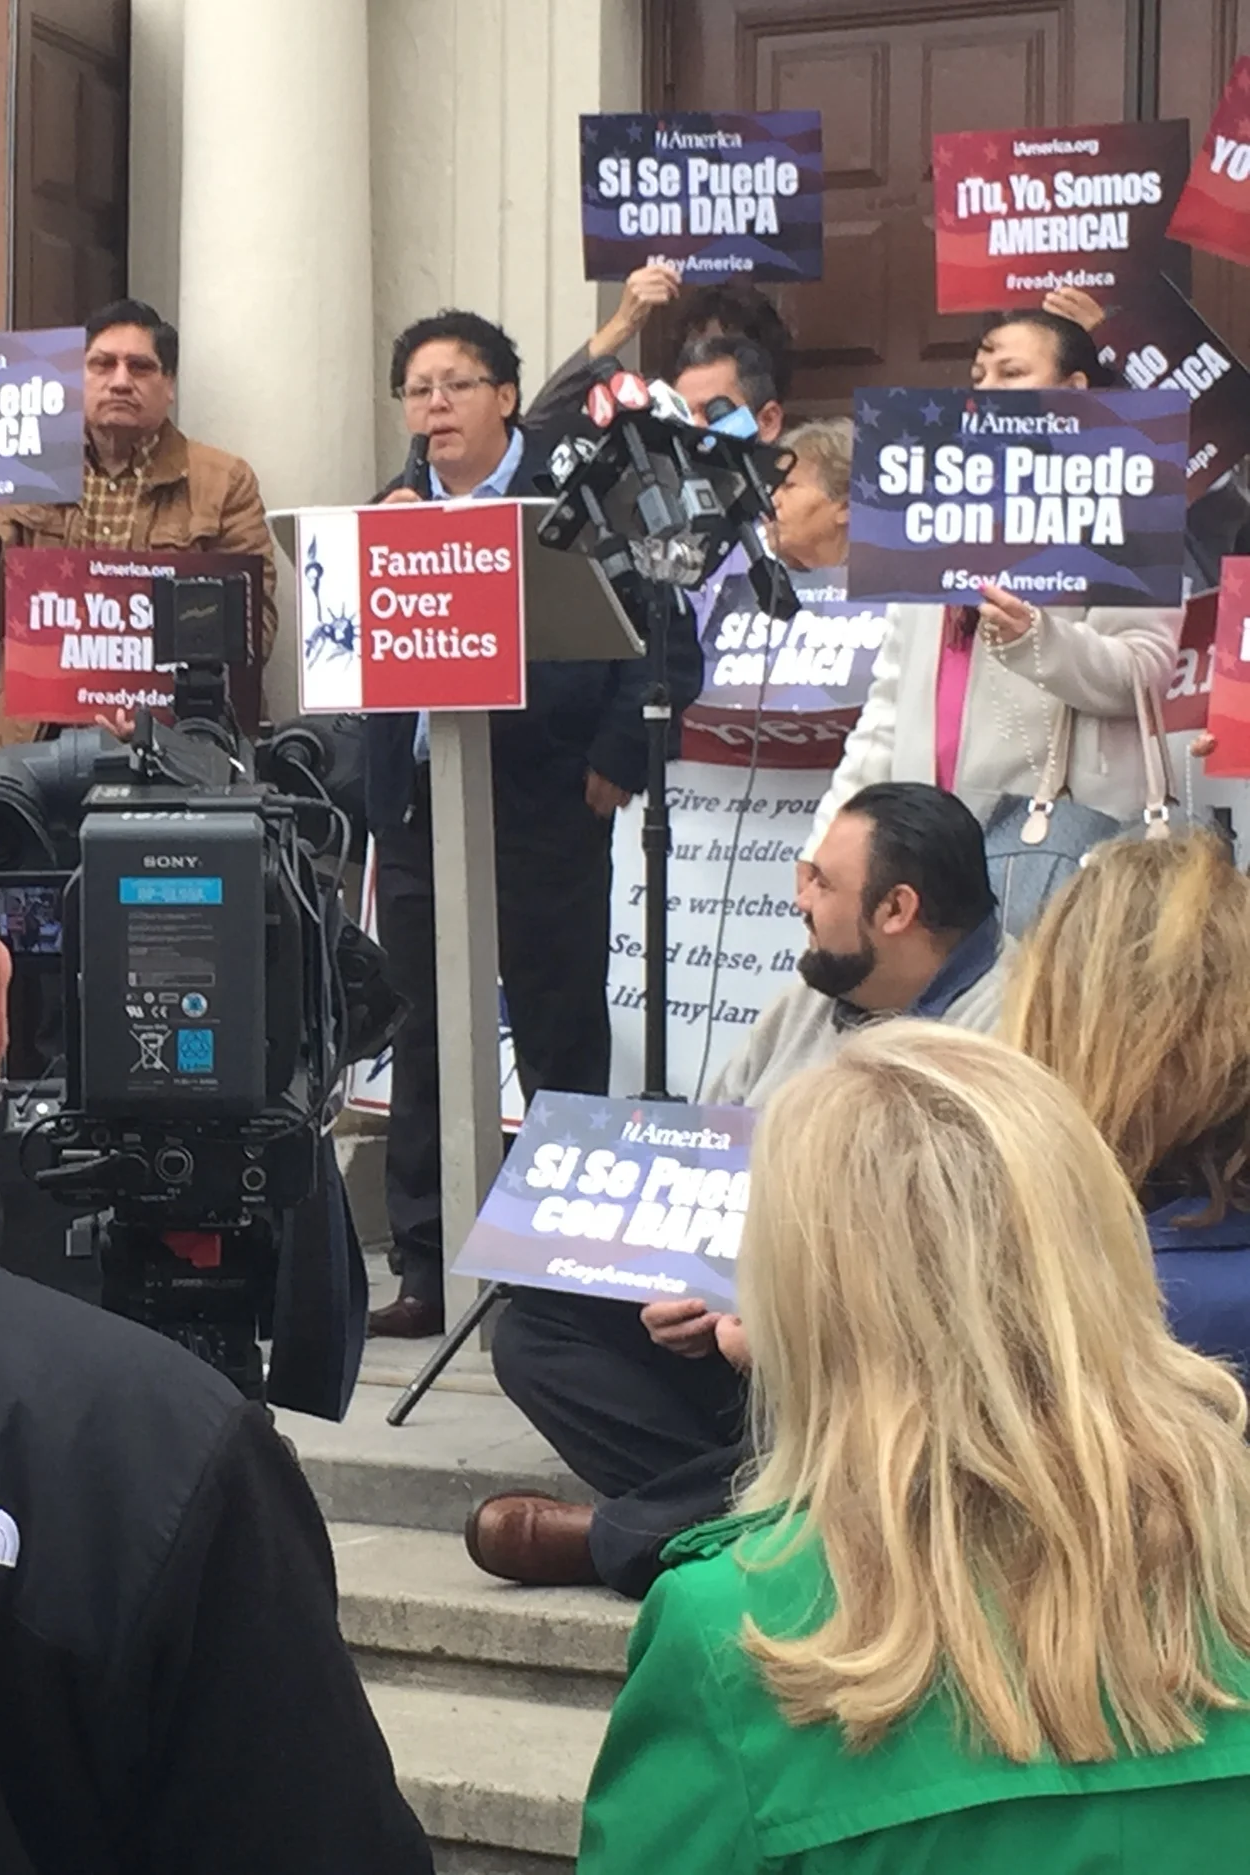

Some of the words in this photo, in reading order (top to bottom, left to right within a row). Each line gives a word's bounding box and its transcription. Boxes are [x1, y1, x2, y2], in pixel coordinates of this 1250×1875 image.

[598, 157, 631, 197] Si
[637, 157, 680, 197] Se
[688, 156, 798, 196] Puede
[1009, 175, 1051, 212] Yo,
[1054, 171, 1162, 209] Somos
[619, 202, 682, 235] con
[690, 196, 779, 234] DAPA
[988, 212, 1129, 256] AMERICA!
[1006, 270, 1115, 291] #ready4daca
[878, 445, 925, 495] Si
[934, 445, 993, 496] Se
[1004, 447, 1154, 497] Puede
[905, 501, 993, 544] con
[1004, 497, 1124, 545] DAPA
[369, 542, 511, 577] Families
[942, 570, 1087, 592] #SoyAmerica
[84, 593, 126, 632] Yo,
[370, 587, 453, 618] Over
[371, 627, 498, 660] Politics
[664, 786, 720, 812] Give
[724, 799, 767, 814] me
[143, 856, 199, 868] SONY
[685, 944, 762, 975] these,
[577, 1149, 640, 1198] Se
[531, 1196, 625, 1241] con
[546, 1257, 687, 1293] #SoyAmerica
